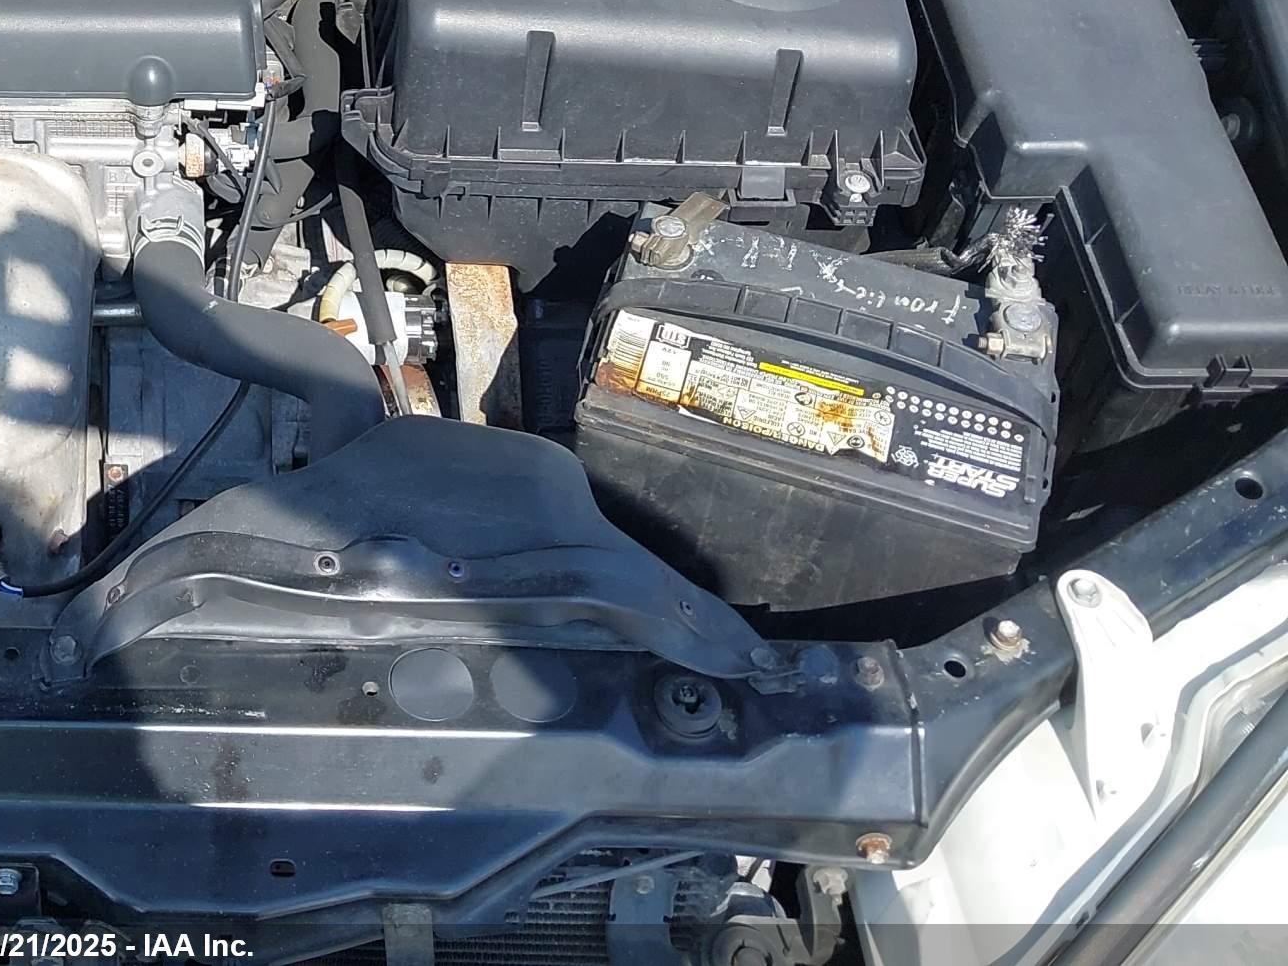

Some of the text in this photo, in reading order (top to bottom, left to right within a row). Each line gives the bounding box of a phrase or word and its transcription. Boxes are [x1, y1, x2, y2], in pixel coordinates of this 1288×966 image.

[722, 416, 825, 452] DANGER/POISON
[927, 466, 1005, 497] SUPER
[928, 458, 1020, 491] START
